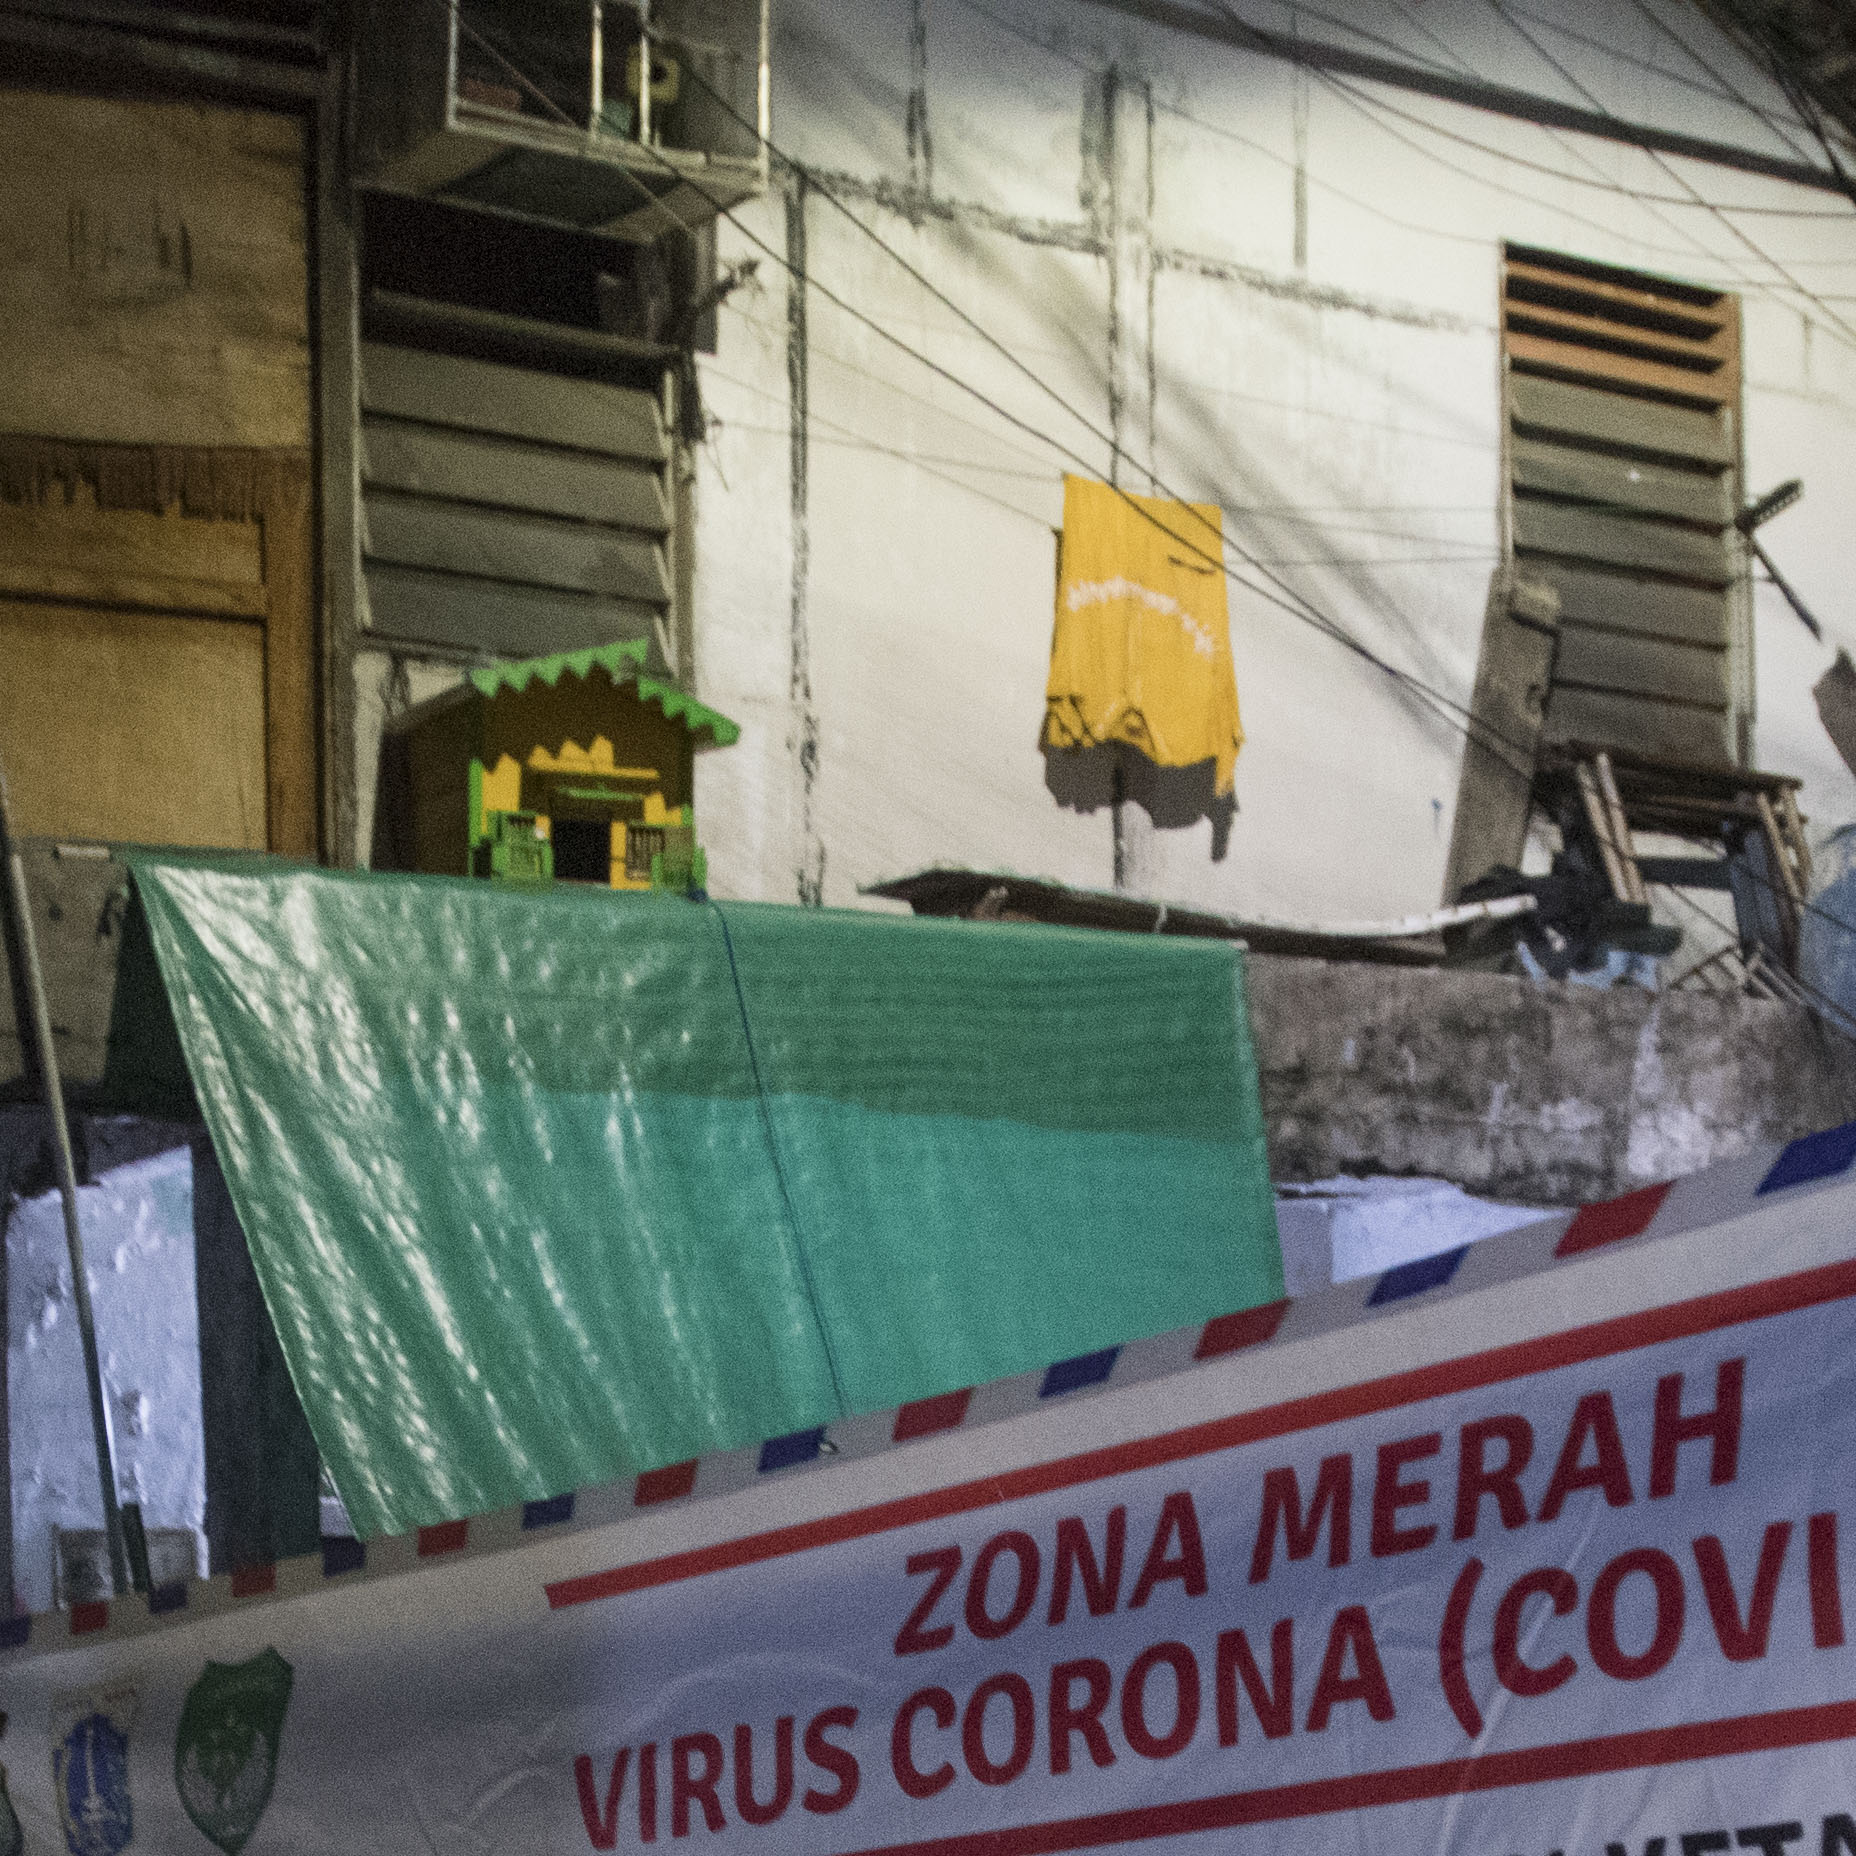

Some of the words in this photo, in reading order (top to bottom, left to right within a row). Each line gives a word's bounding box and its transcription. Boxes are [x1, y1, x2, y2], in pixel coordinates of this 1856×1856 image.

[893, 1492, 1207, 1656] ZONA
[1248, 1358, 1745, 1584] MERAH
[575, 1706, 860, 1850] VIRUS
[890, 1605, 1394, 1799] CORONA
